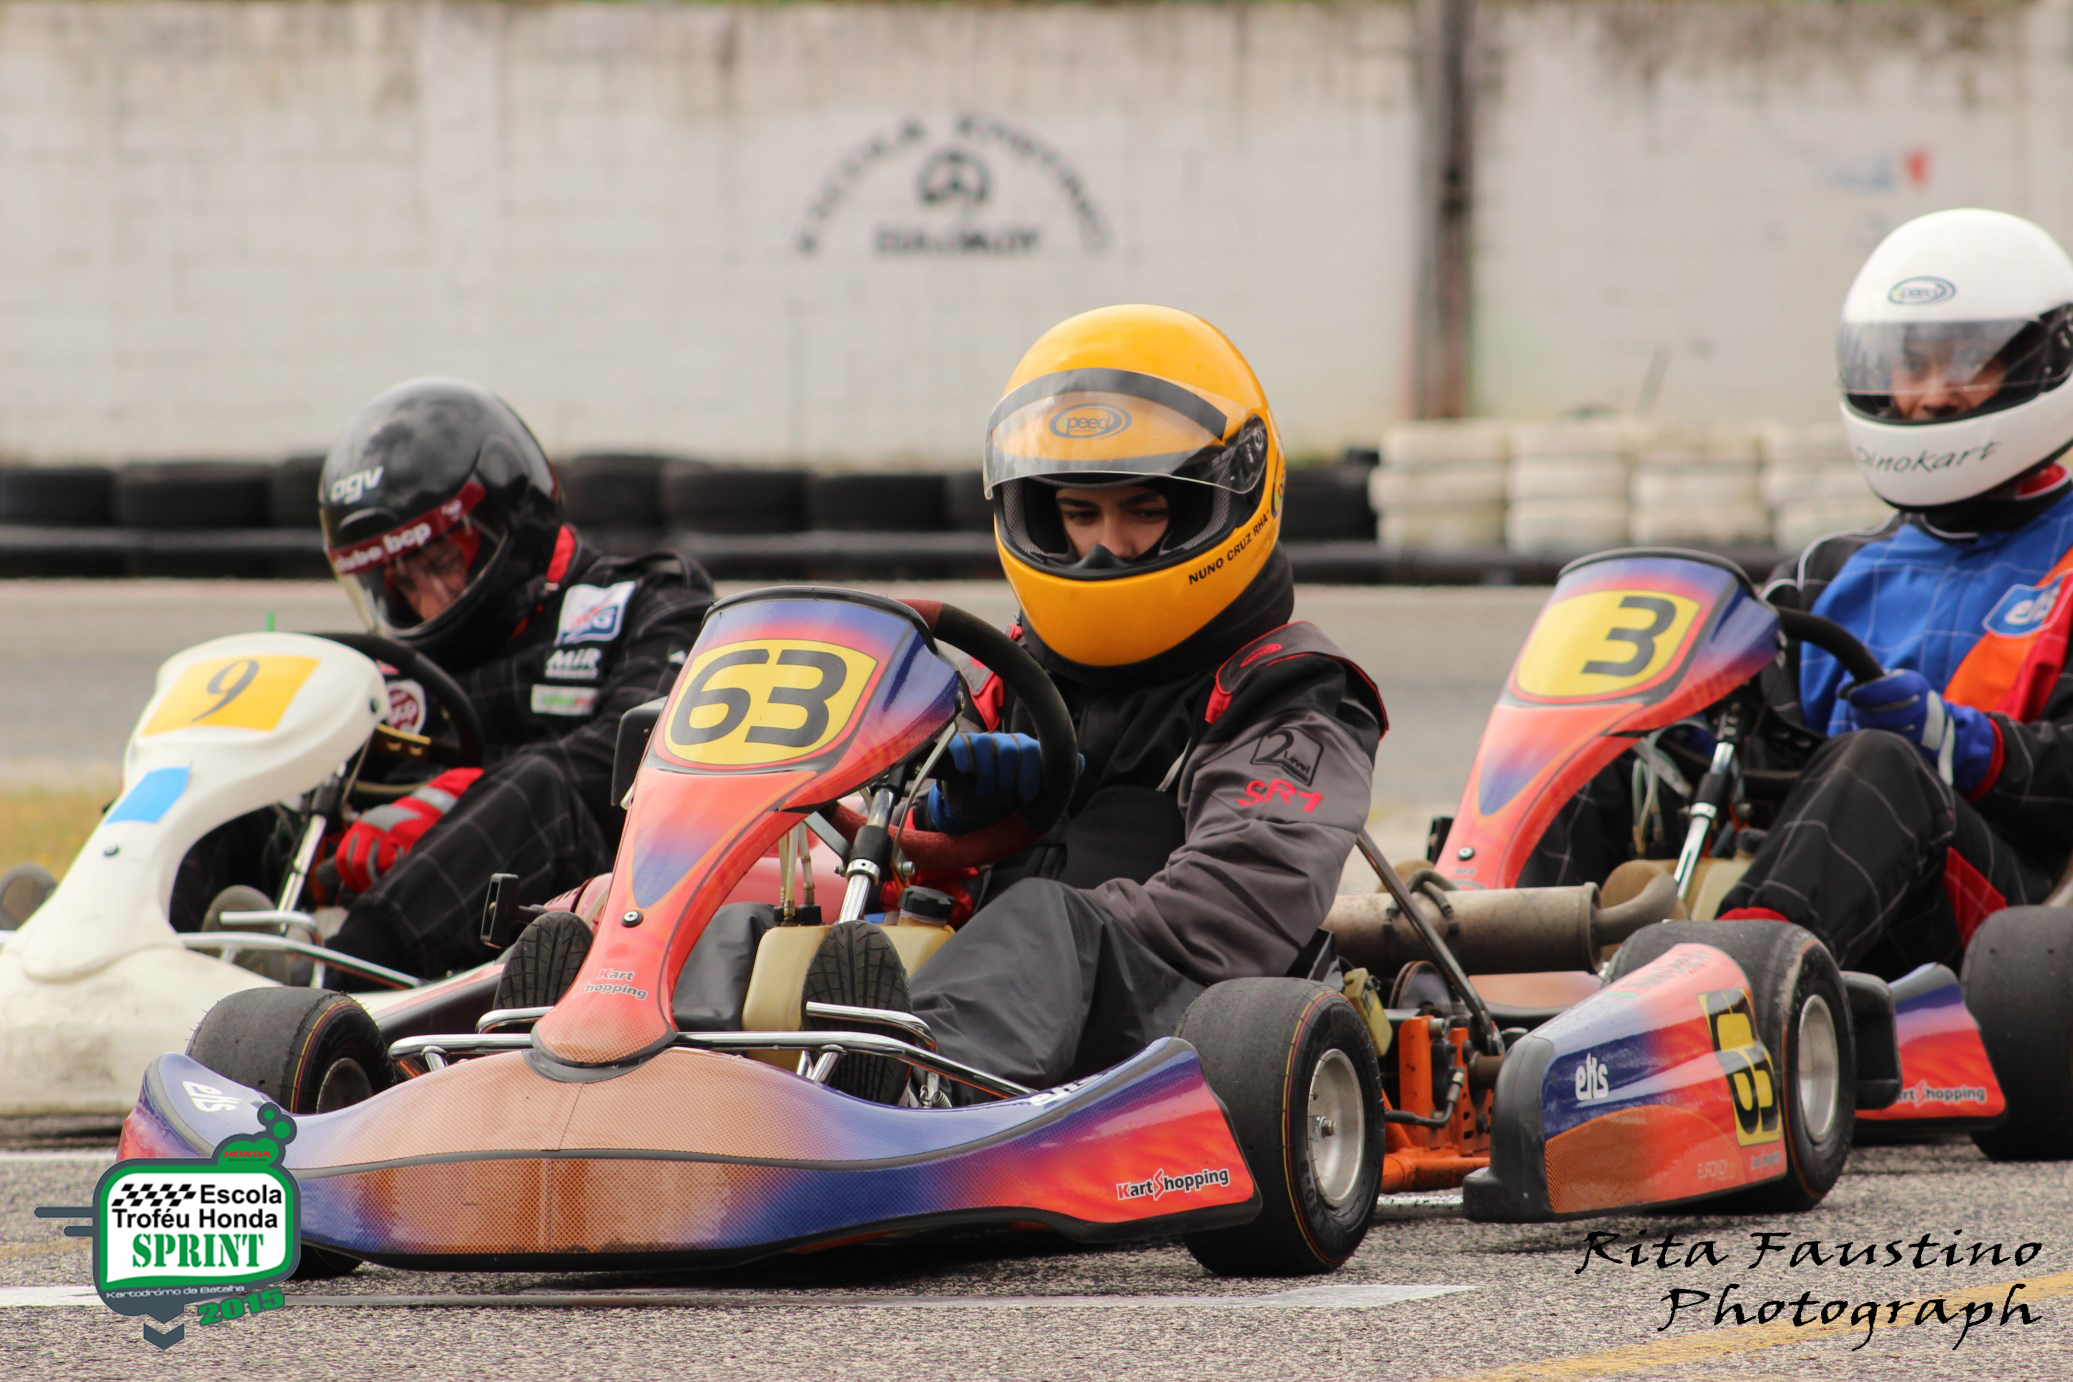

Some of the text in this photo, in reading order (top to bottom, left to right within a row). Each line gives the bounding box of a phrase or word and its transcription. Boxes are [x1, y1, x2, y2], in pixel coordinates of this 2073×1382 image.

[330, 465, 384, 504] agv
[383, 522, 432, 554] bcp
[1188, 557, 1225, 585] NUNO
[1227, 532, 1252, 562] CRUZ
[1580, 596, 1676, 676] 3
[191, 659, 260, 722] 9
[669, 648, 848, 748] 63
[581, 980, 648, 1000] Shopping
[597, 969, 635, 982] Kart
